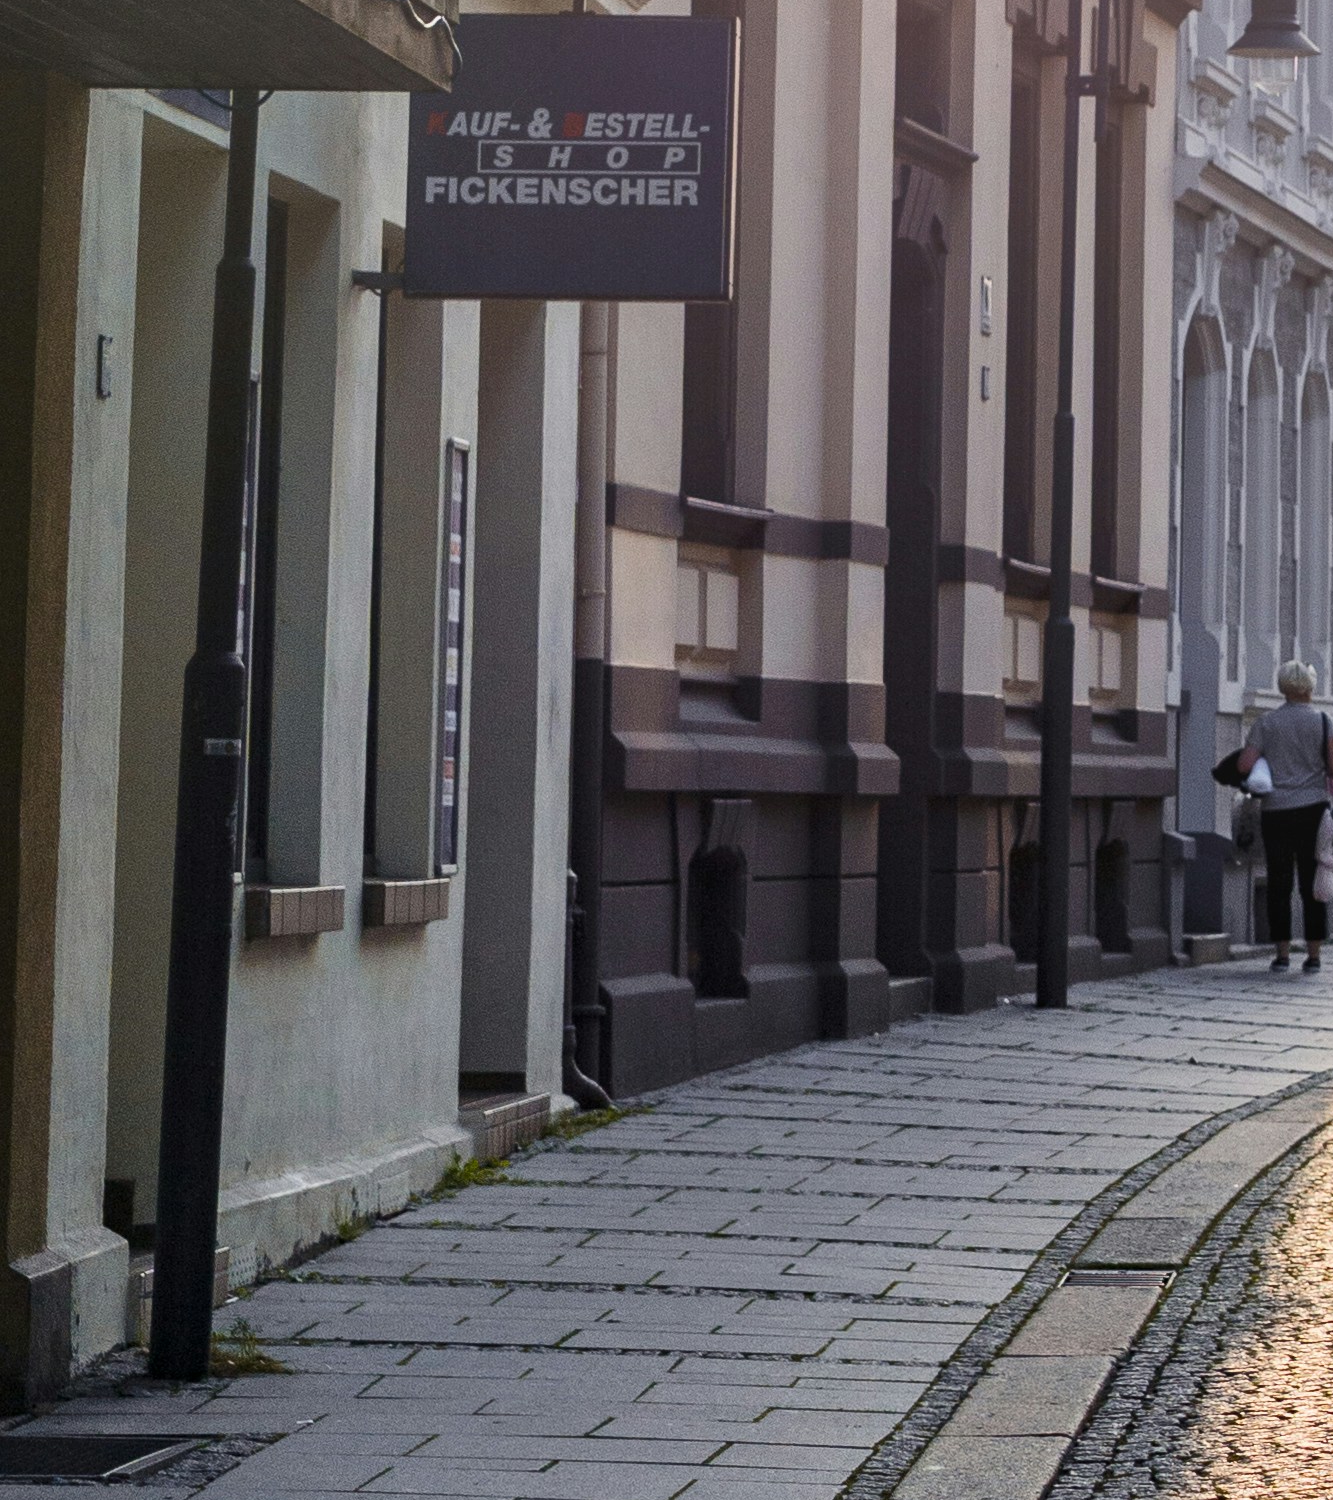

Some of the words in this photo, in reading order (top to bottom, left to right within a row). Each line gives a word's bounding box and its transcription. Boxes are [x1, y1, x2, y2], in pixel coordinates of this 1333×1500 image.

[426, 110, 520, 137] KAUF-
[527, 107, 552, 138] &
[562, 112, 710, 138] BESTELL-
[425, 177, 699, 206] FICKENSCHER
